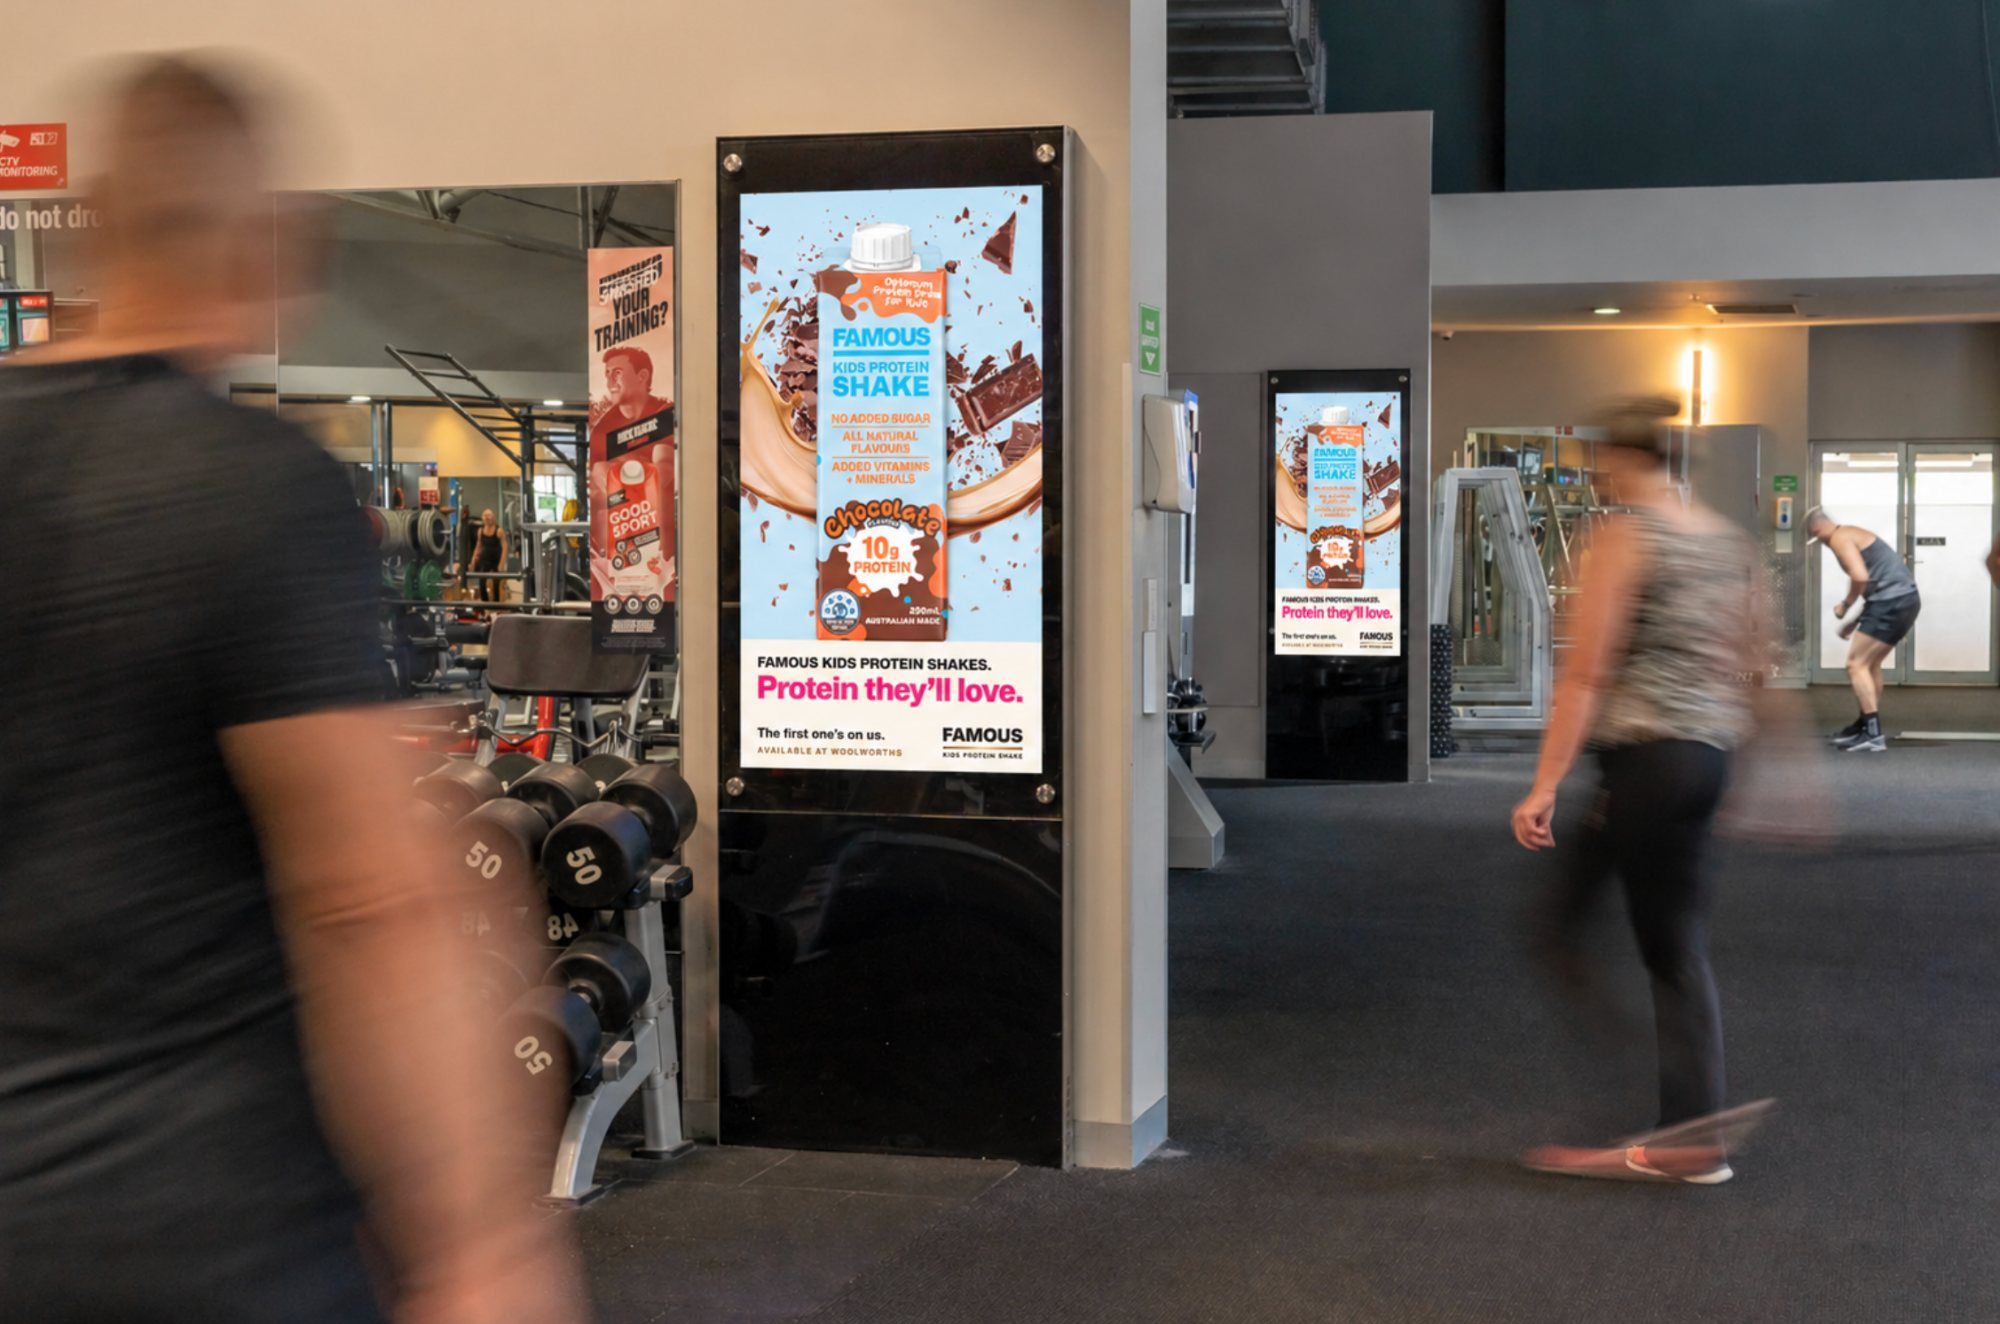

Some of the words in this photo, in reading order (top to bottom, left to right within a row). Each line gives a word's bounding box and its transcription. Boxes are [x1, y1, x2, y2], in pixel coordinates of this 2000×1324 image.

[26, 204, 62, 230] not
[67, 203, 103, 229] dro
[612, 287, 650, 320] YOUR
[594, 301, 669, 352] TRAINING?
[833, 327, 931, 347] FAMOUS
[833, 362, 865, 373] KIDS
[869, 361, 929, 373] PROTEIN
[832, 375, 930, 397] SHAKE
[831, 413, 848, 423] NO
[850, 413, 889, 423] ADDED
[891, 413, 931, 423] SUGAR
[842, 431, 863, 441] ALL
[866, 431, 918, 441] NATURAL
[851, 443, 911, 453] FLAVOURS
[832, 462, 871, 472] ADDED
[873, 461, 930, 472] VITAMINS
[855, 473, 916, 484] MINERALS
[1314, 470, 1356, 480] SHAKE
[609, 500, 651, 525] GOOD
[824, 498, 941, 539] Chocolate
[613, 511, 657, 538] SPORT
[862, 535, 899, 560] 10g
[853, 561, 911, 573] PROTEIN
[865, 617, 915, 625] AUSTRALIAN
[1282, 605, 1324, 619] Protein
[1327, 605, 1364, 622] they'll
[1366, 606, 1393, 619] love.
[1359, 632, 1393, 641] FAMOUS
[757, 656, 818, 669] FAMOUS
[822, 657, 857, 669] KIDS
[860, 658, 924, 670] PROTEIN
[927, 659, 992, 671] SHAKES.
[757, 675, 858, 701] Protein
[864, 676, 950, 707] they'll
[958, 678, 1024, 703] love.
[757, 727, 780, 739] The
[783, 727, 809, 740] first
[811, 728, 845, 741] one's
[847, 731, 863, 741] on
[866, 731, 885, 741] us.
[943, 727, 1023, 743] FAMOUS
[757, 747, 812, 756] AVAILABLE
[814, 747, 828, 756] AT
[831, 748, 902, 757] WOOLWORTHS
[465, 840, 503, 880] 50
[566, 846, 603, 886] 50
[513, 1035, 553, 1076] 50
